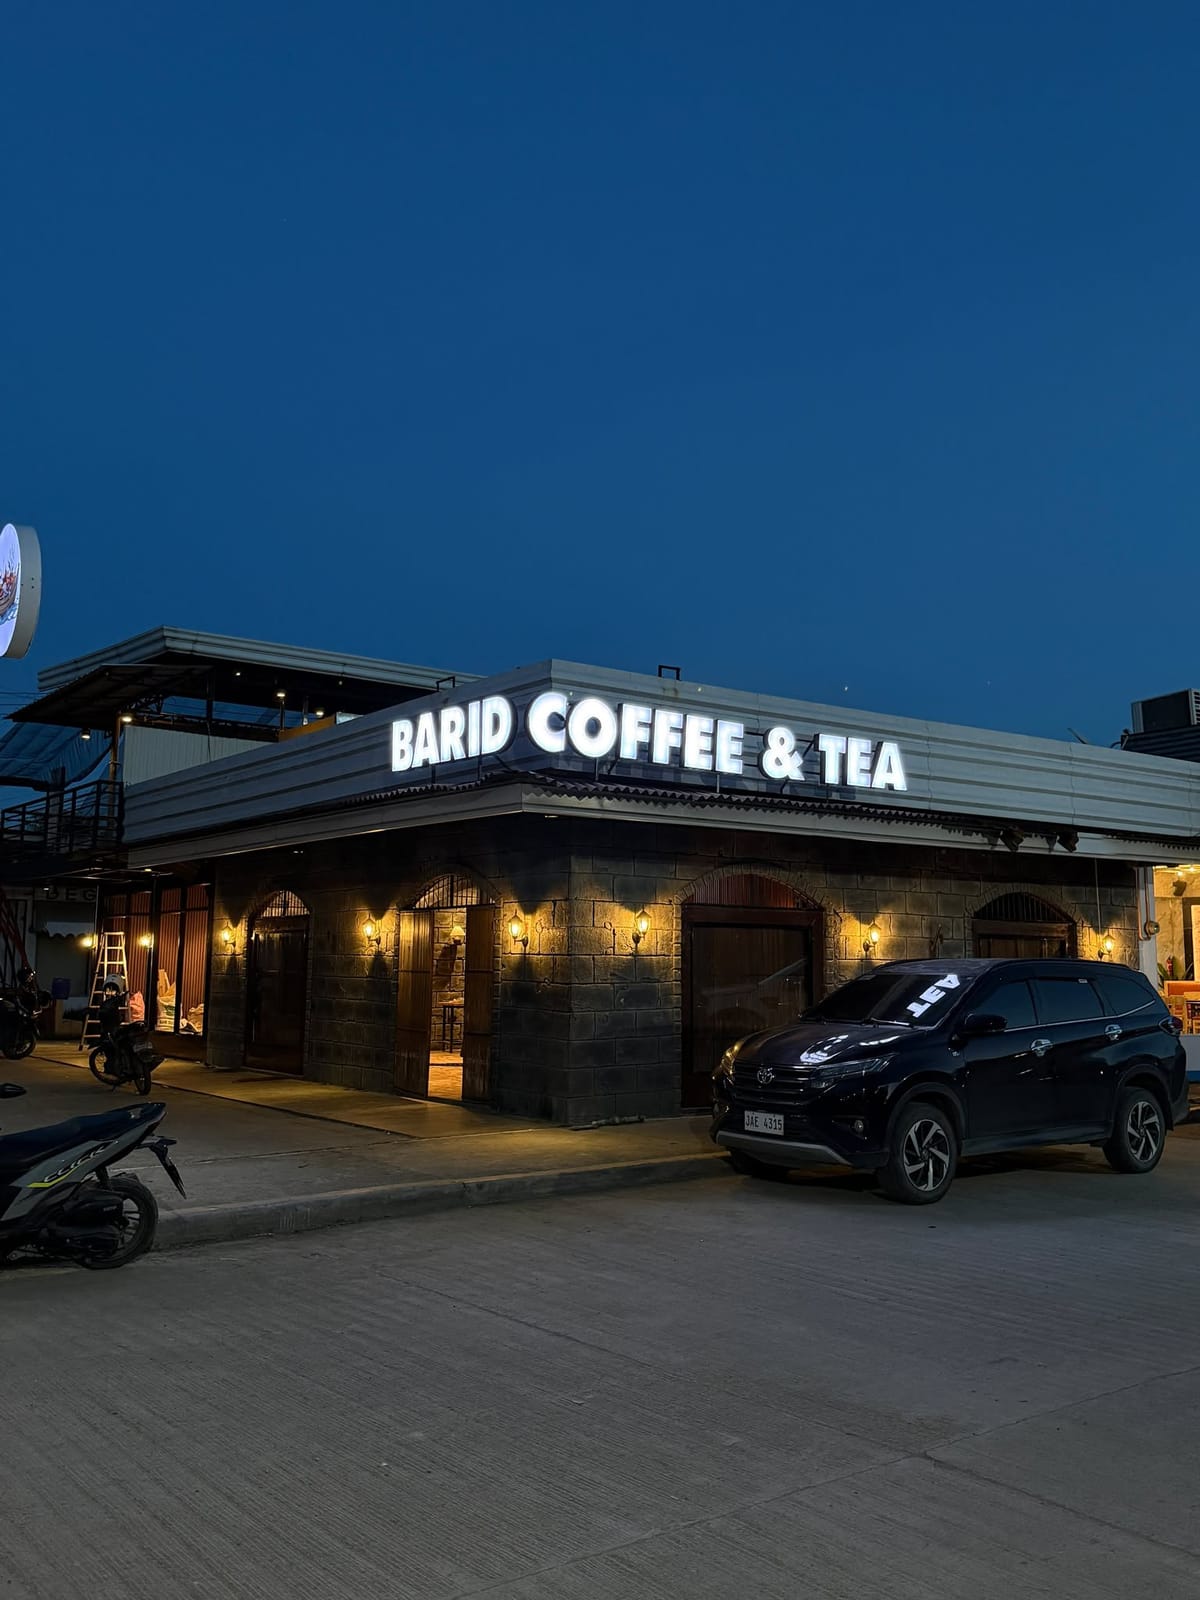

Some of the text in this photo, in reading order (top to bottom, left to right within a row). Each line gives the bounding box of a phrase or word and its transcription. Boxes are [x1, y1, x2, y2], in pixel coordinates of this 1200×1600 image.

[391, 691, 908, 792] BARID COFFEE & TEA
[763, 1117, 783, 1131] 4315
